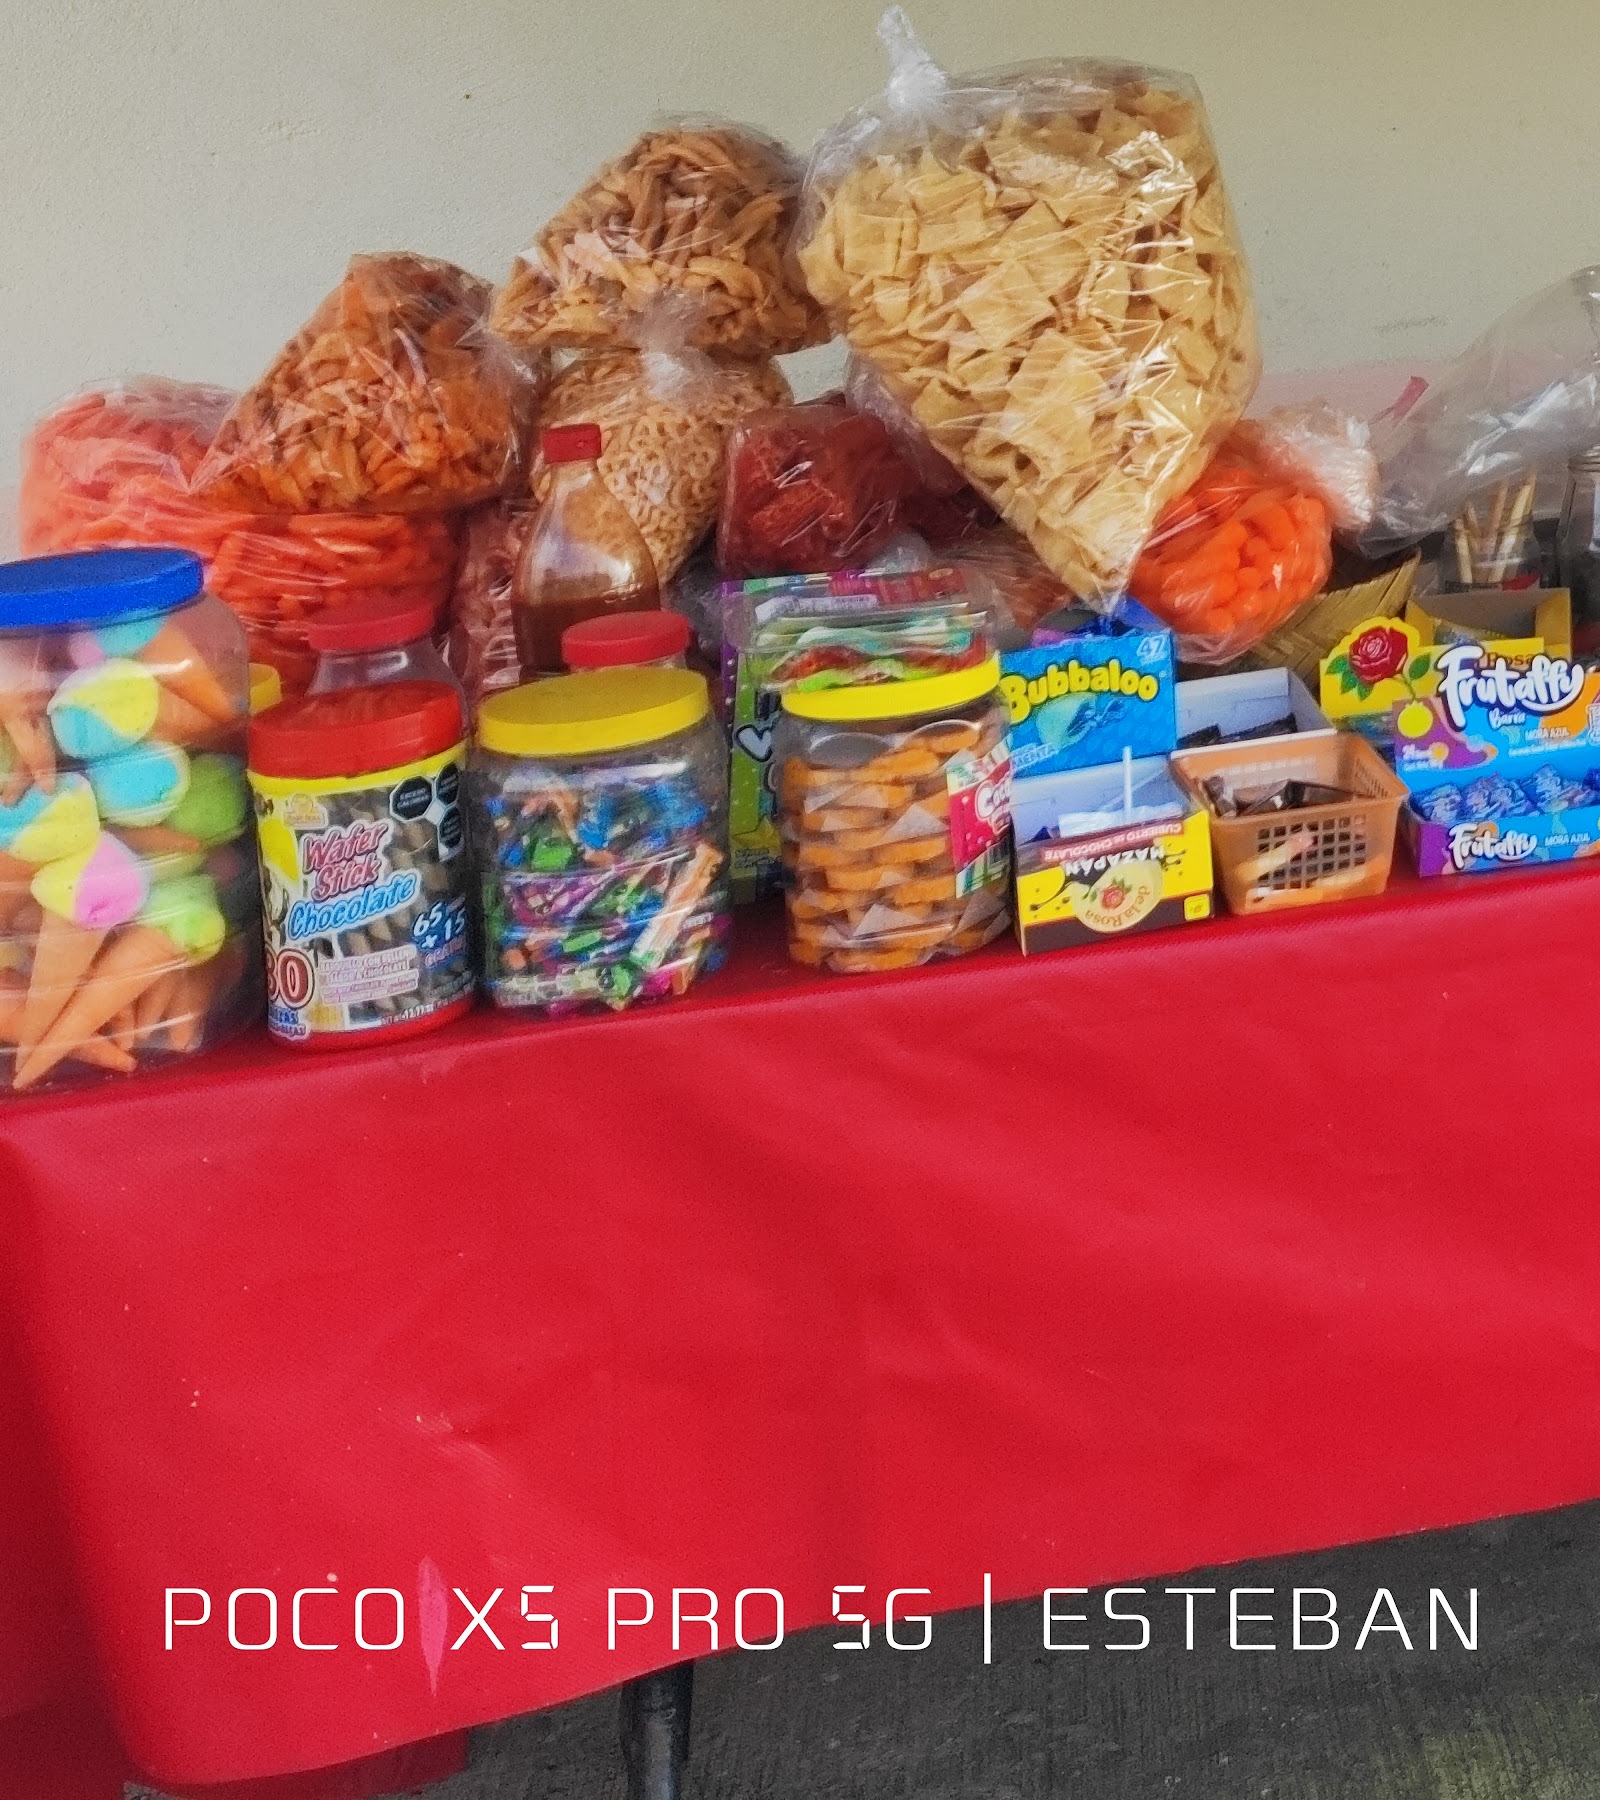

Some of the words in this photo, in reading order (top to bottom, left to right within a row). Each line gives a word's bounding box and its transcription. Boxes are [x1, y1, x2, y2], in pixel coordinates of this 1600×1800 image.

[1000, 658, 1159, 725] Bubbaloo
[1437, 645, 1585, 729] Frutaffy
[303, 820, 389, 874] Wafer
[1043, 838, 1116, 861] CHOCOLATE
[1126, 822, 1182, 841] CUBIERTO
[1448, 821, 1538, 869] Frutaffy
[311, 853, 383, 902] Stick
[287, 872, 418, 942] Chocolate
